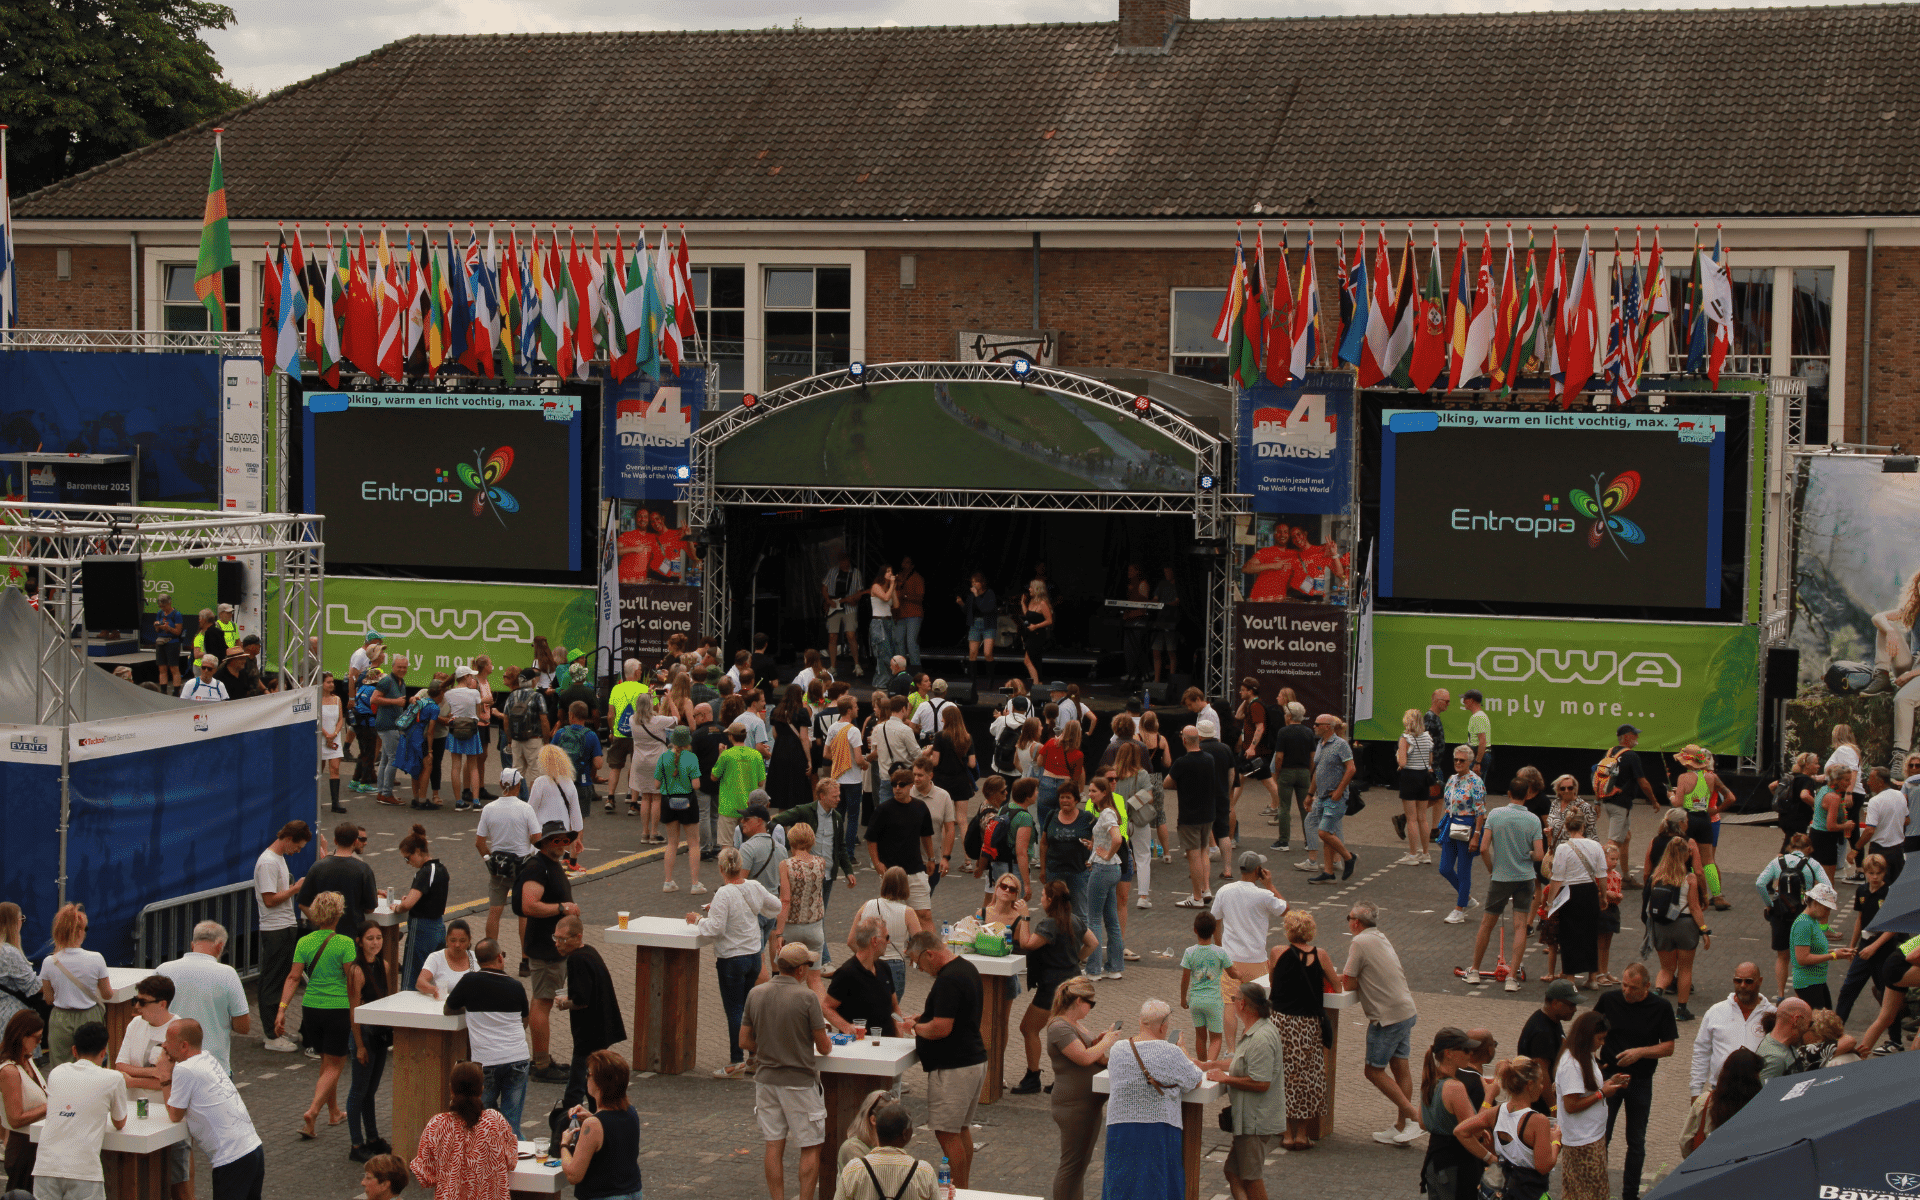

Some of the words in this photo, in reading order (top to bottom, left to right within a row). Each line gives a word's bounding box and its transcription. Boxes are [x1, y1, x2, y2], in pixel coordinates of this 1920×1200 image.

[385, 397, 415, 405] warm
[419, 397, 431, 405] en
[436, 396, 459, 406] licht
[462, 397, 505, 408] vochtig,
[509, 398, 536, 407] max.
[646, 387, 685, 433] 4
[1259, 421, 1282, 433] DE
[1286, 394, 1331, 442] 4
[1483, 416, 1520, 424] warm
[1524, 416, 1540, 425] en
[1545, 415, 1574, 426] licht
[1578, 416, 1631, 428] vochtig,
[1636, 418, 1668, 427] max.
[226, 432, 259, 444] LOWA
[621, 433, 686, 448] DAAGSE
[1258, 444, 1331, 459] DAAGSE
[66, 482, 109, 491] Barometer
[110, 483, 130, 491] 2025
[1292, 477, 1310, 485] jezelf
[362, 481, 463, 507] Entropia
[1452, 509, 1575, 538] Entropia
[619, 597, 648, 610] ou'll
[651, 600, 692, 611] never
[326, 604, 534, 644] LOWA
[621, 616, 646, 629] ork
[648, 618, 691, 631] alone
[1242, 615, 1287, 630] You'll
[1291, 619, 1338, 632] never
[1243, 636, 1285, 651] work
[1288, 637, 1336, 653] alone
[1426, 645, 1682, 688] LOWA
[11, 742, 47, 751] EVENTS
